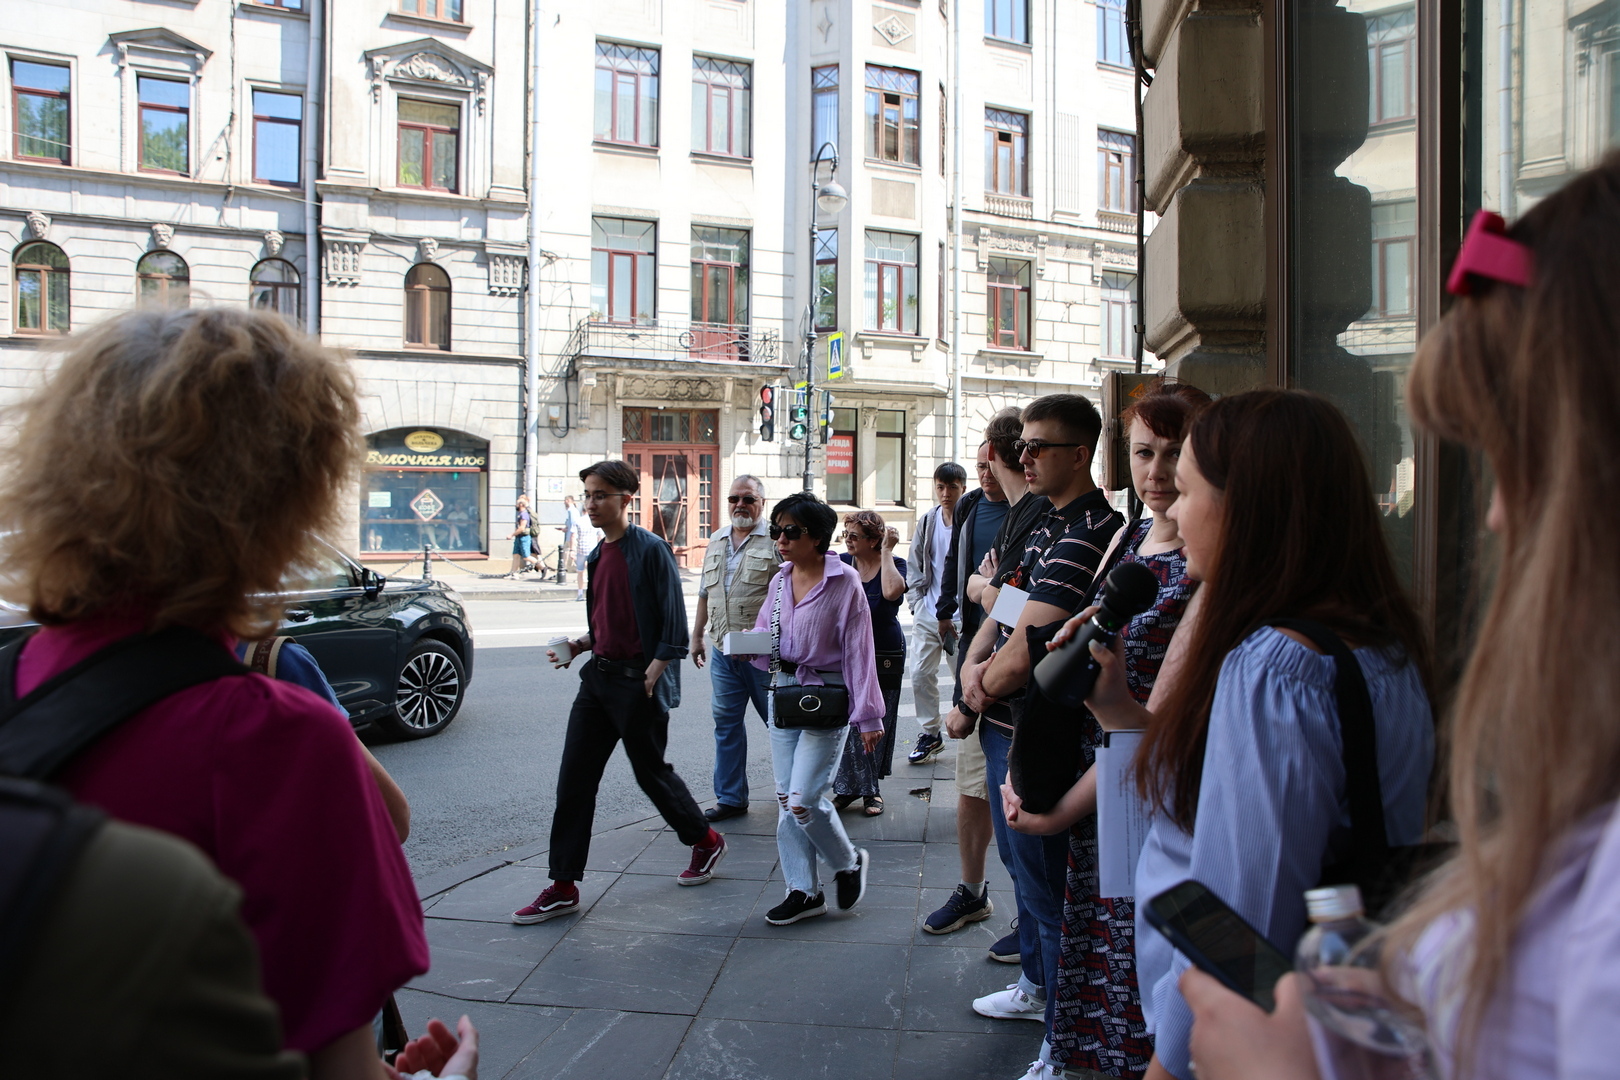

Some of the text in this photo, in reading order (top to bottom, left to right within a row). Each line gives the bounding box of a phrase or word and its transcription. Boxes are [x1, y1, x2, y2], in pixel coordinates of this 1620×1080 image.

[827, 439, 850, 448] АРЕНДА
[366, 451, 451, 466] Булочная
[828, 460, 849, 468] АРЕНДА
